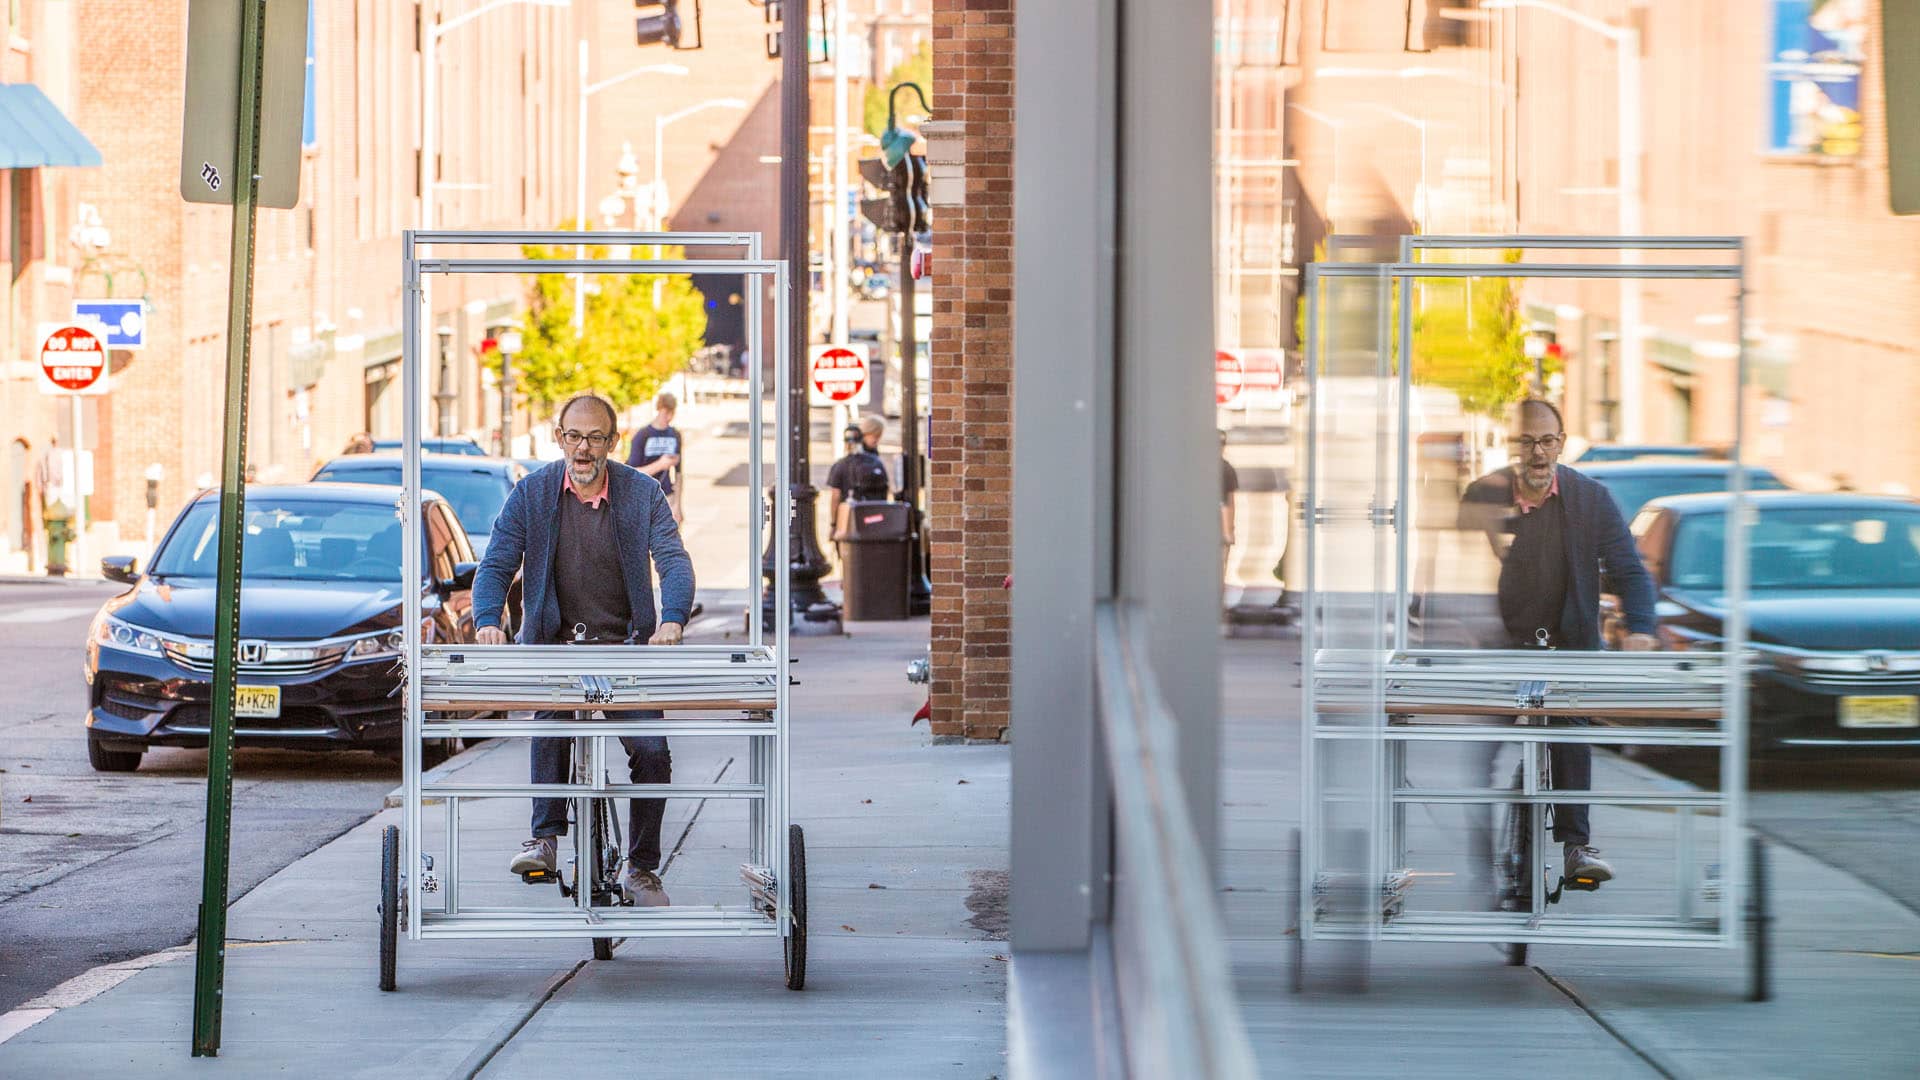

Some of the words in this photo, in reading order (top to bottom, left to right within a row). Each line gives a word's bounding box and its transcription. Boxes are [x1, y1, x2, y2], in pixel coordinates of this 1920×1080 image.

[48, 337, 67, 350] DO
[71, 337, 96, 350] NOT
[53, 367, 92, 380] ENTER
